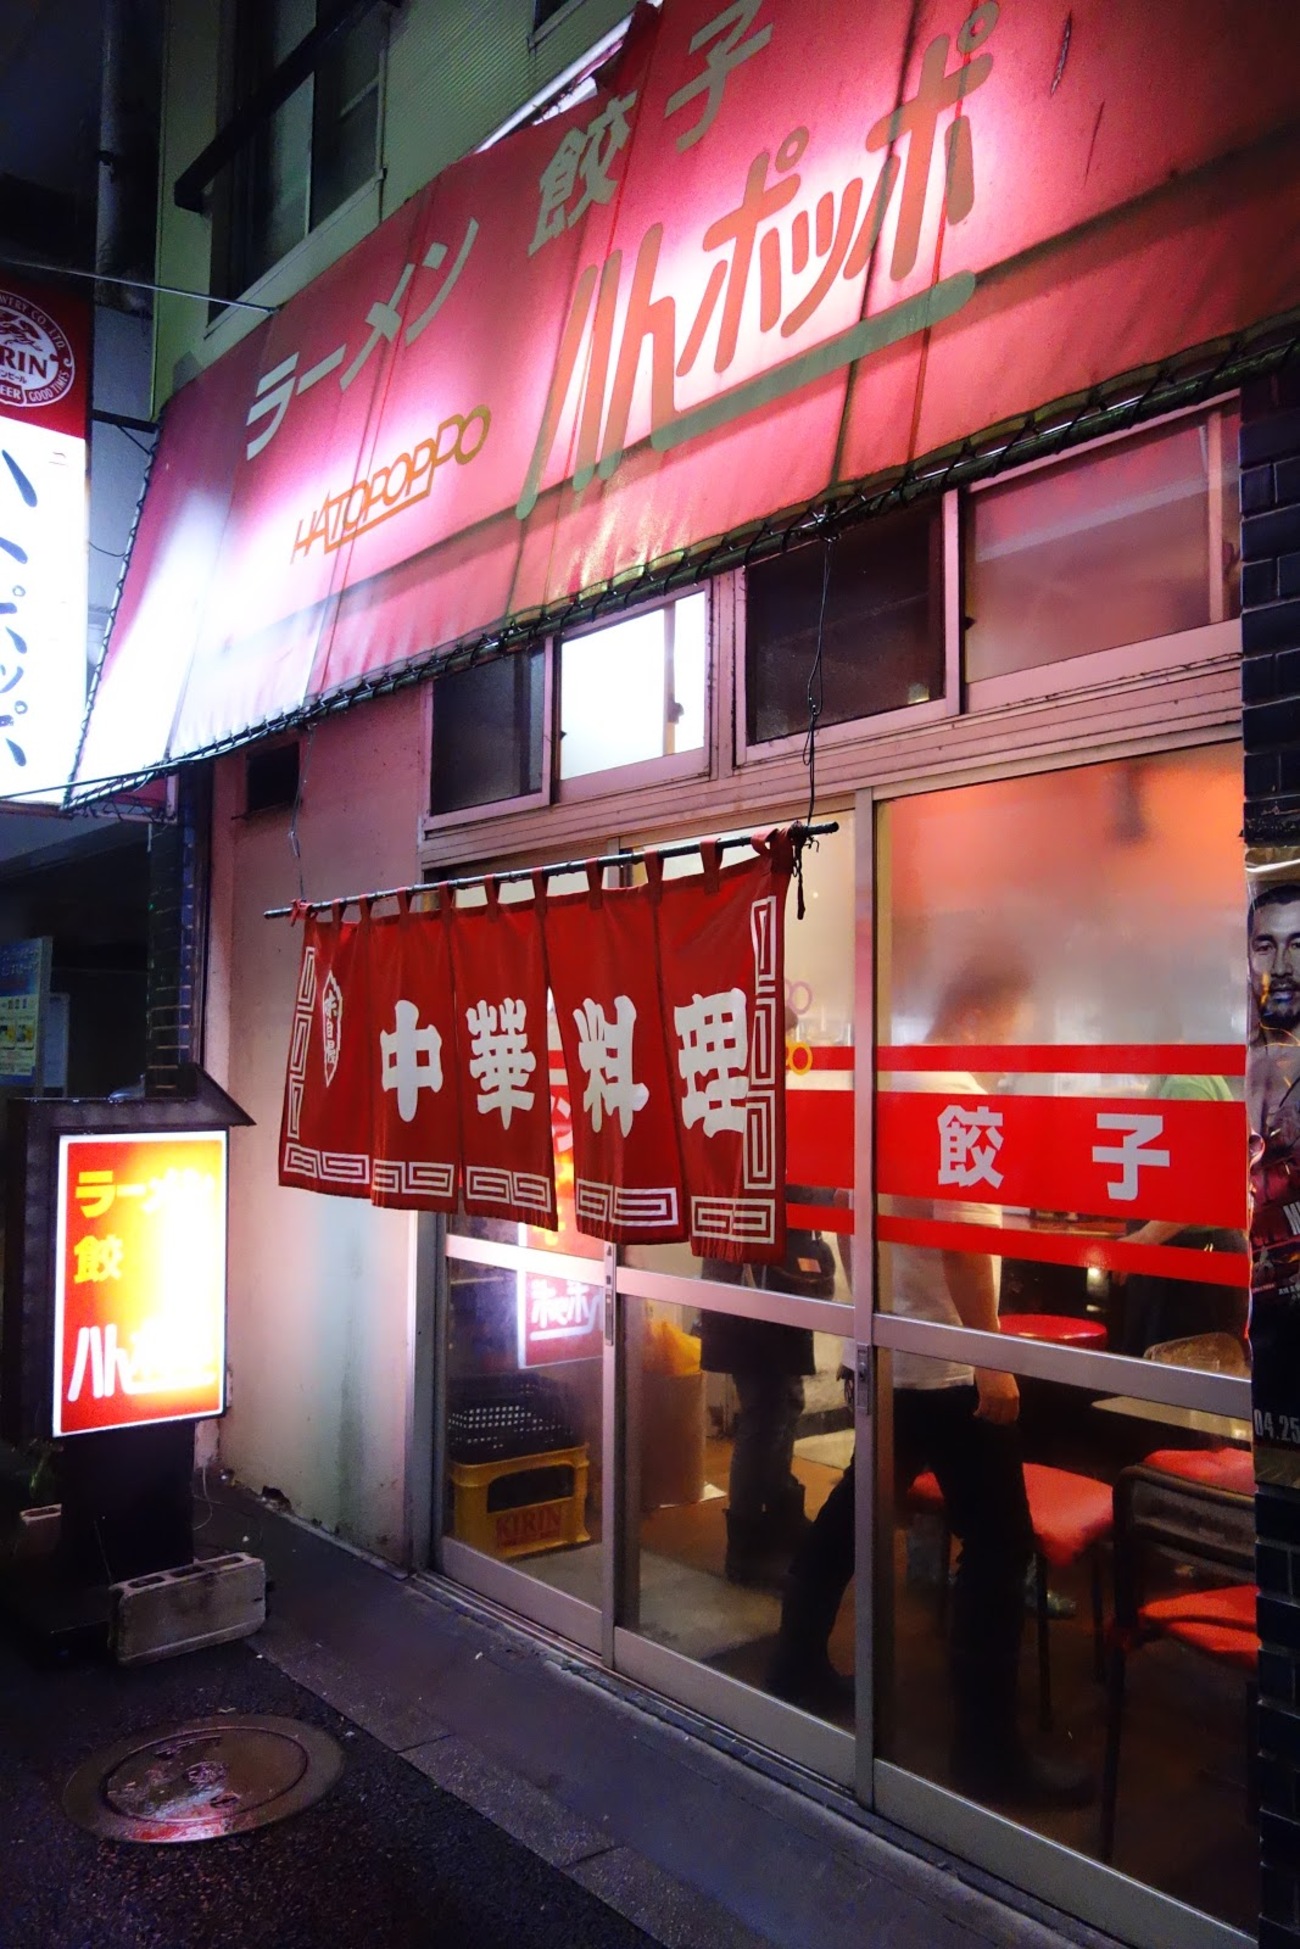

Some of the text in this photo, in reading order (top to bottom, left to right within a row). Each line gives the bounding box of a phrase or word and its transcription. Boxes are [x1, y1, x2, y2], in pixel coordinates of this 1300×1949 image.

[246, 0, 774, 460] ラーメン 餃子
[28, 369, 69, 402] GOOD TIMES
[290, 404, 491, 565] HATOPOPPO
[379, 987, 749, 1139] 中華料理
[937, 1104, 1171, 1201] 餃子
[496, 1504, 562, 1547] KIRIN
